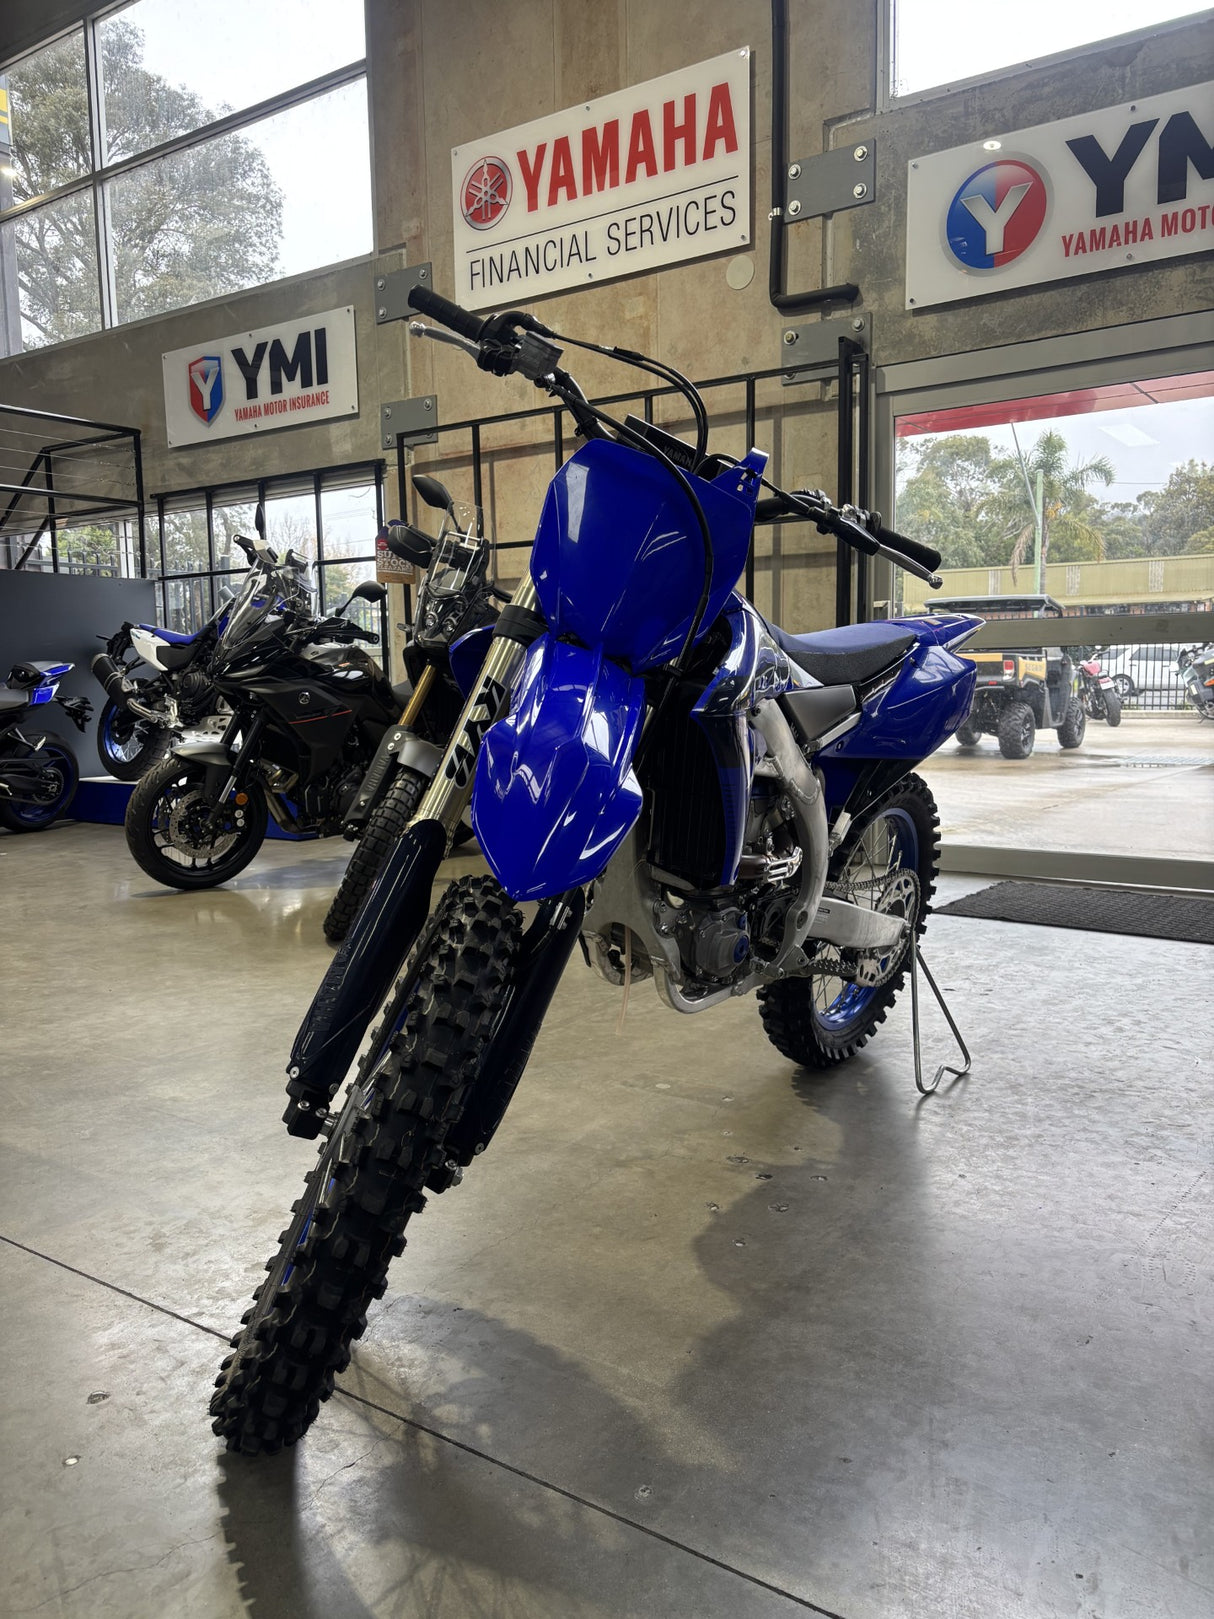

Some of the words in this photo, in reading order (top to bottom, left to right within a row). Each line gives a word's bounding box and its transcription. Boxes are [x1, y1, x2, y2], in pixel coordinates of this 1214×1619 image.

[516, 82, 739, 213] YAMAHA
[470, 230, 597, 290] FINANCIAL
[607, 190, 736, 256] SERVICES
[1061, 217, 1154, 257] YAMAHA
[1161, 204, 1214, 238] MOT
[231, 327, 329, 400] YMI
[234, 404, 263, 422] YAMAHA
[263, 399, 288, 417] MOTOR
[289, 390, 330, 411] INSURANCE
[445, 675, 507, 789] KYB
